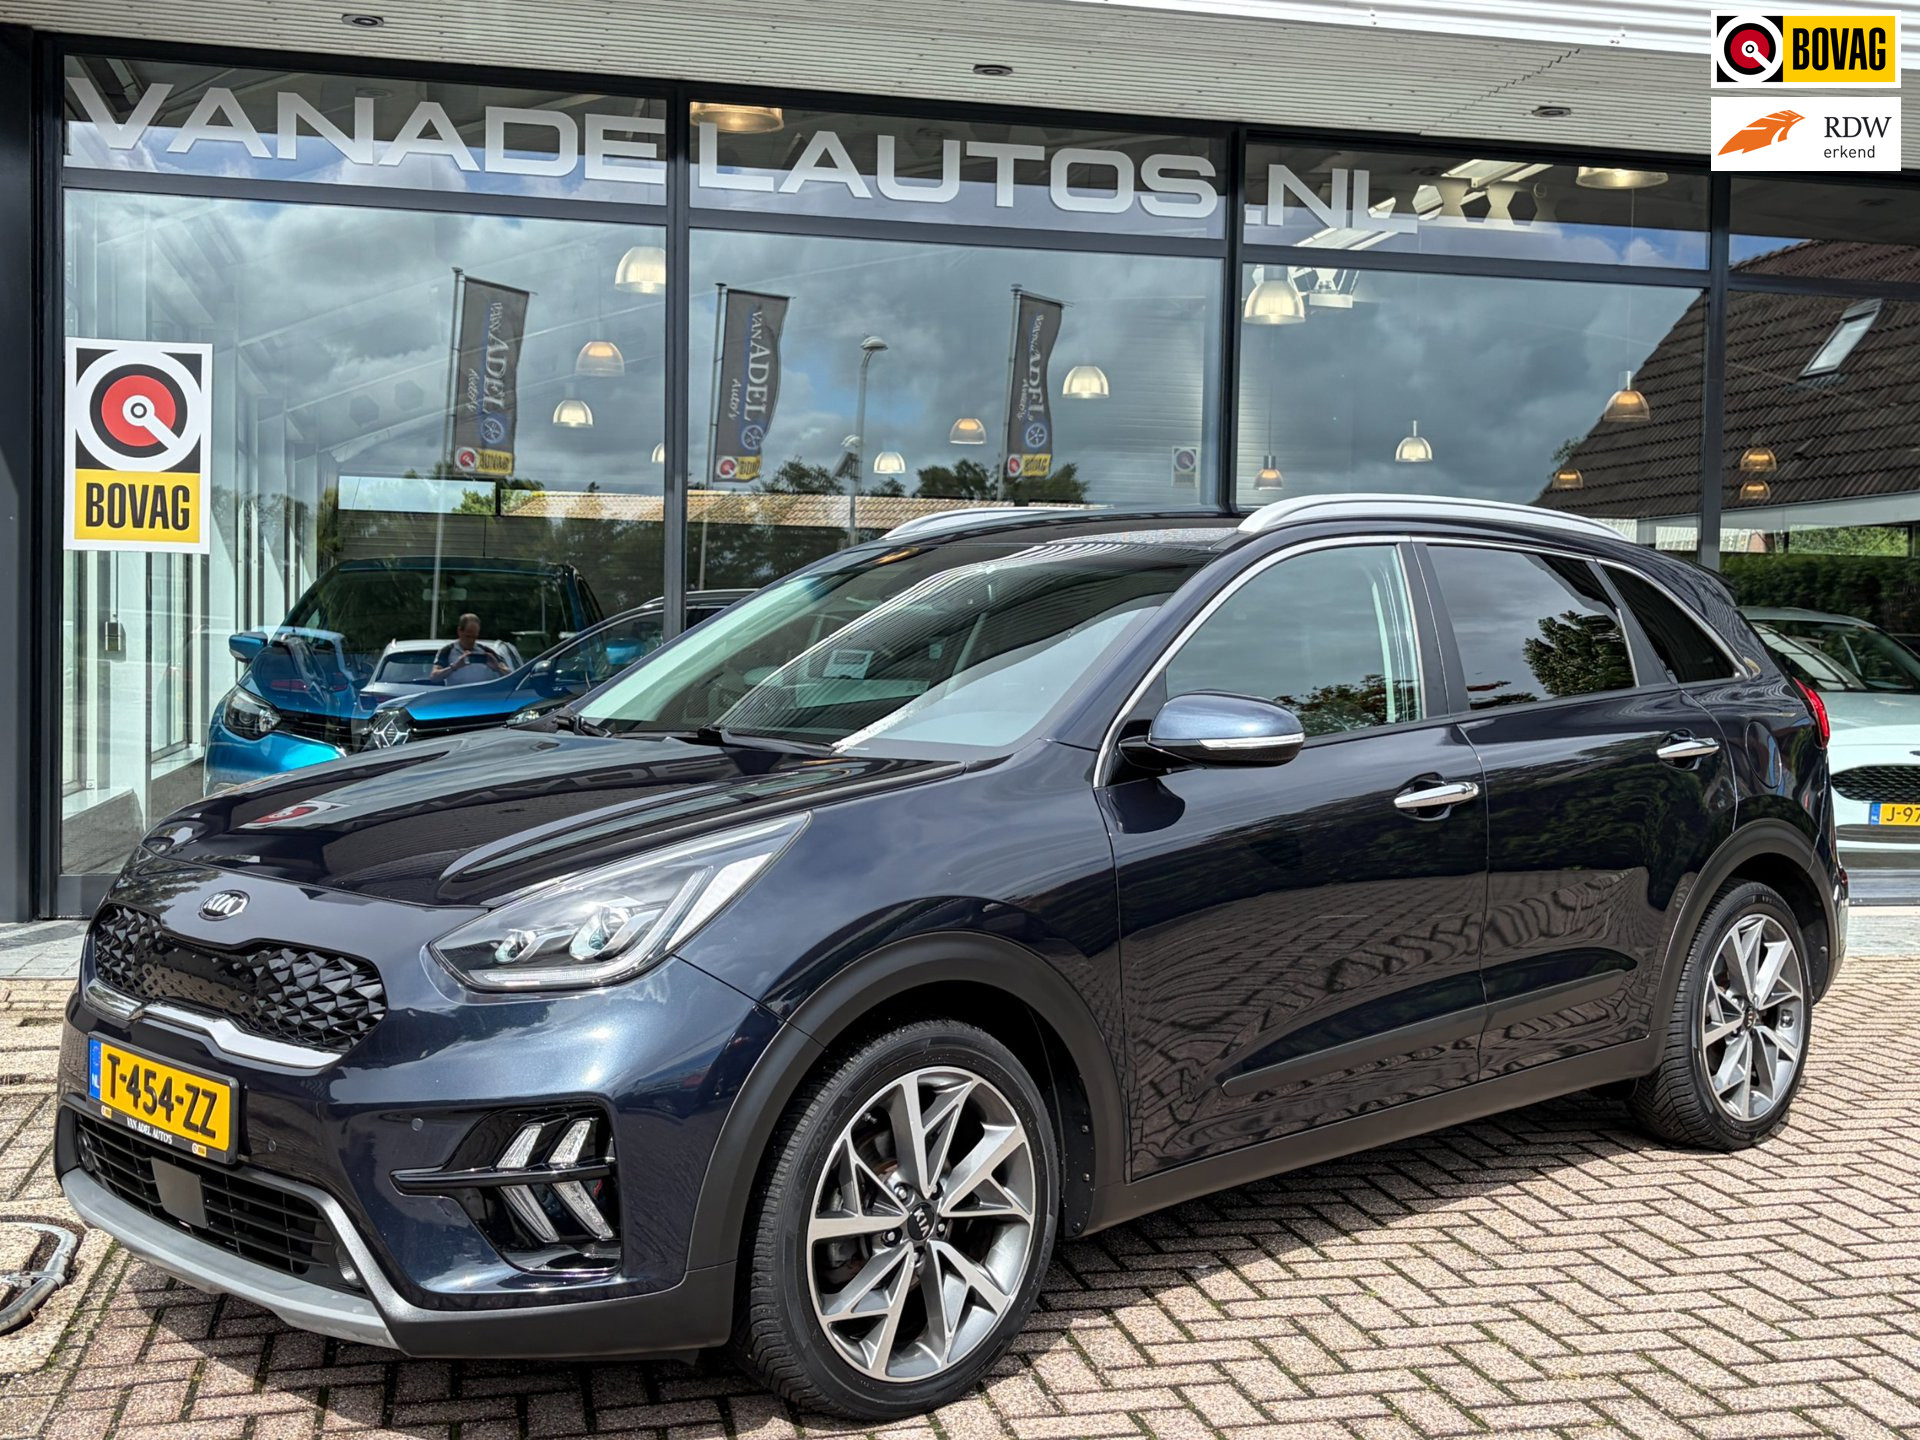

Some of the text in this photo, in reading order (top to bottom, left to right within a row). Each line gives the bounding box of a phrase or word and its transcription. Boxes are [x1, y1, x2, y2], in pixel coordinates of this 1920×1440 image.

[482, 332, 509, 414] ADEL
[743, 311, 771, 422] VAN ADEL
[85, 482, 190, 531] BOVAG
[107, 1053, 217, 1140] T-454-ZZ
[914, 1207, 930, 1237] KIA
